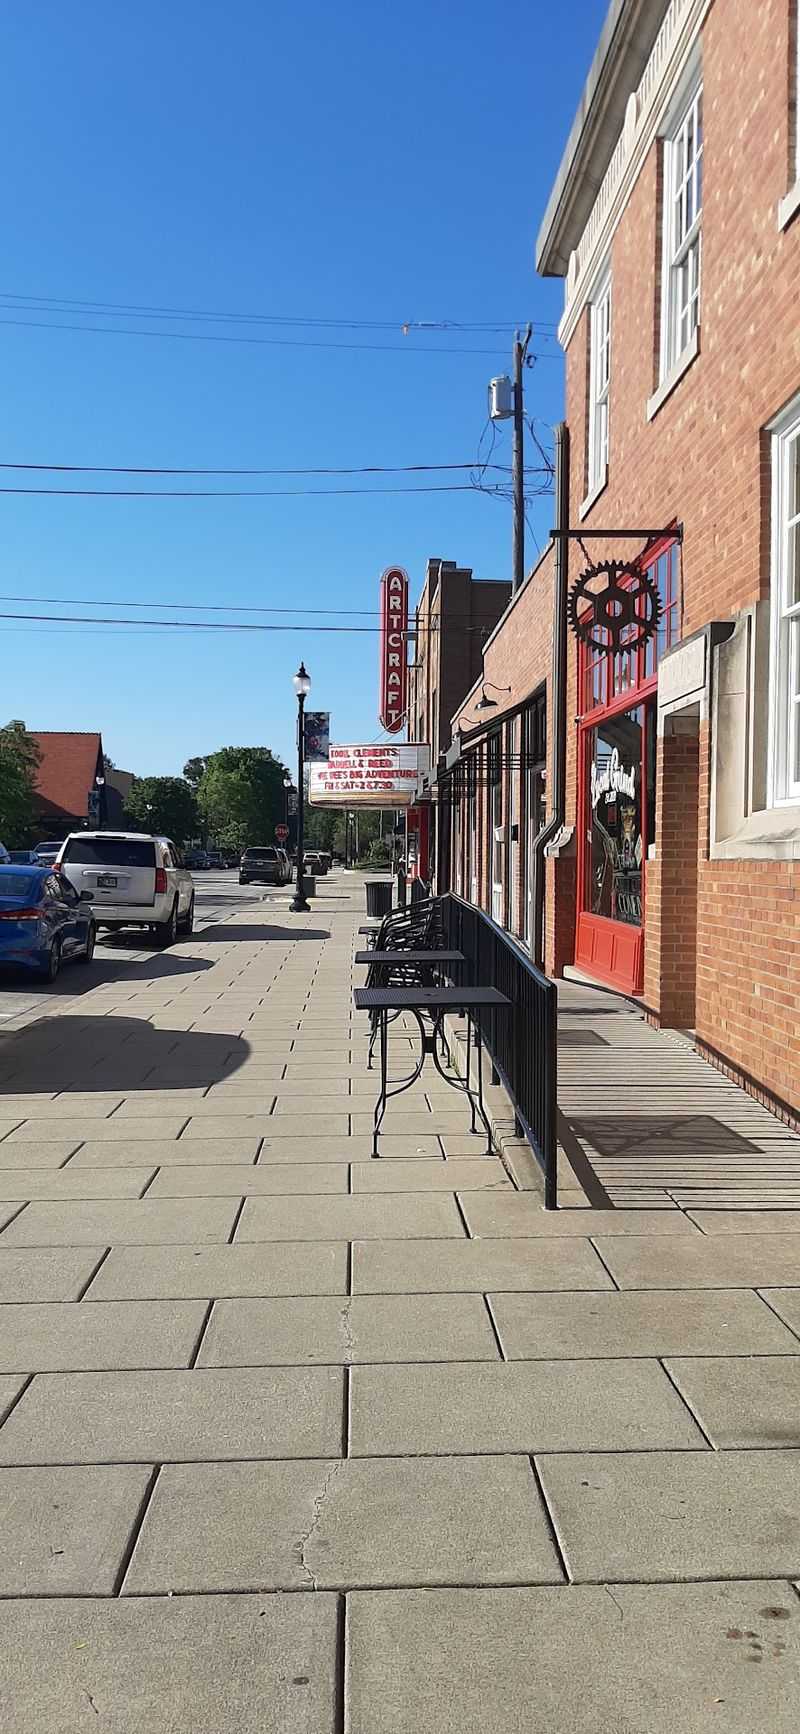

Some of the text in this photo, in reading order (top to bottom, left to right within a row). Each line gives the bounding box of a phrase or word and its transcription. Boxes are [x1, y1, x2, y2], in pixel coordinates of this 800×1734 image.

[387, 576, 402, 724] ARTCRAFT
[349, 770, 363, 779] BIG
[364, 769, 417, 779] ADVENTURE
